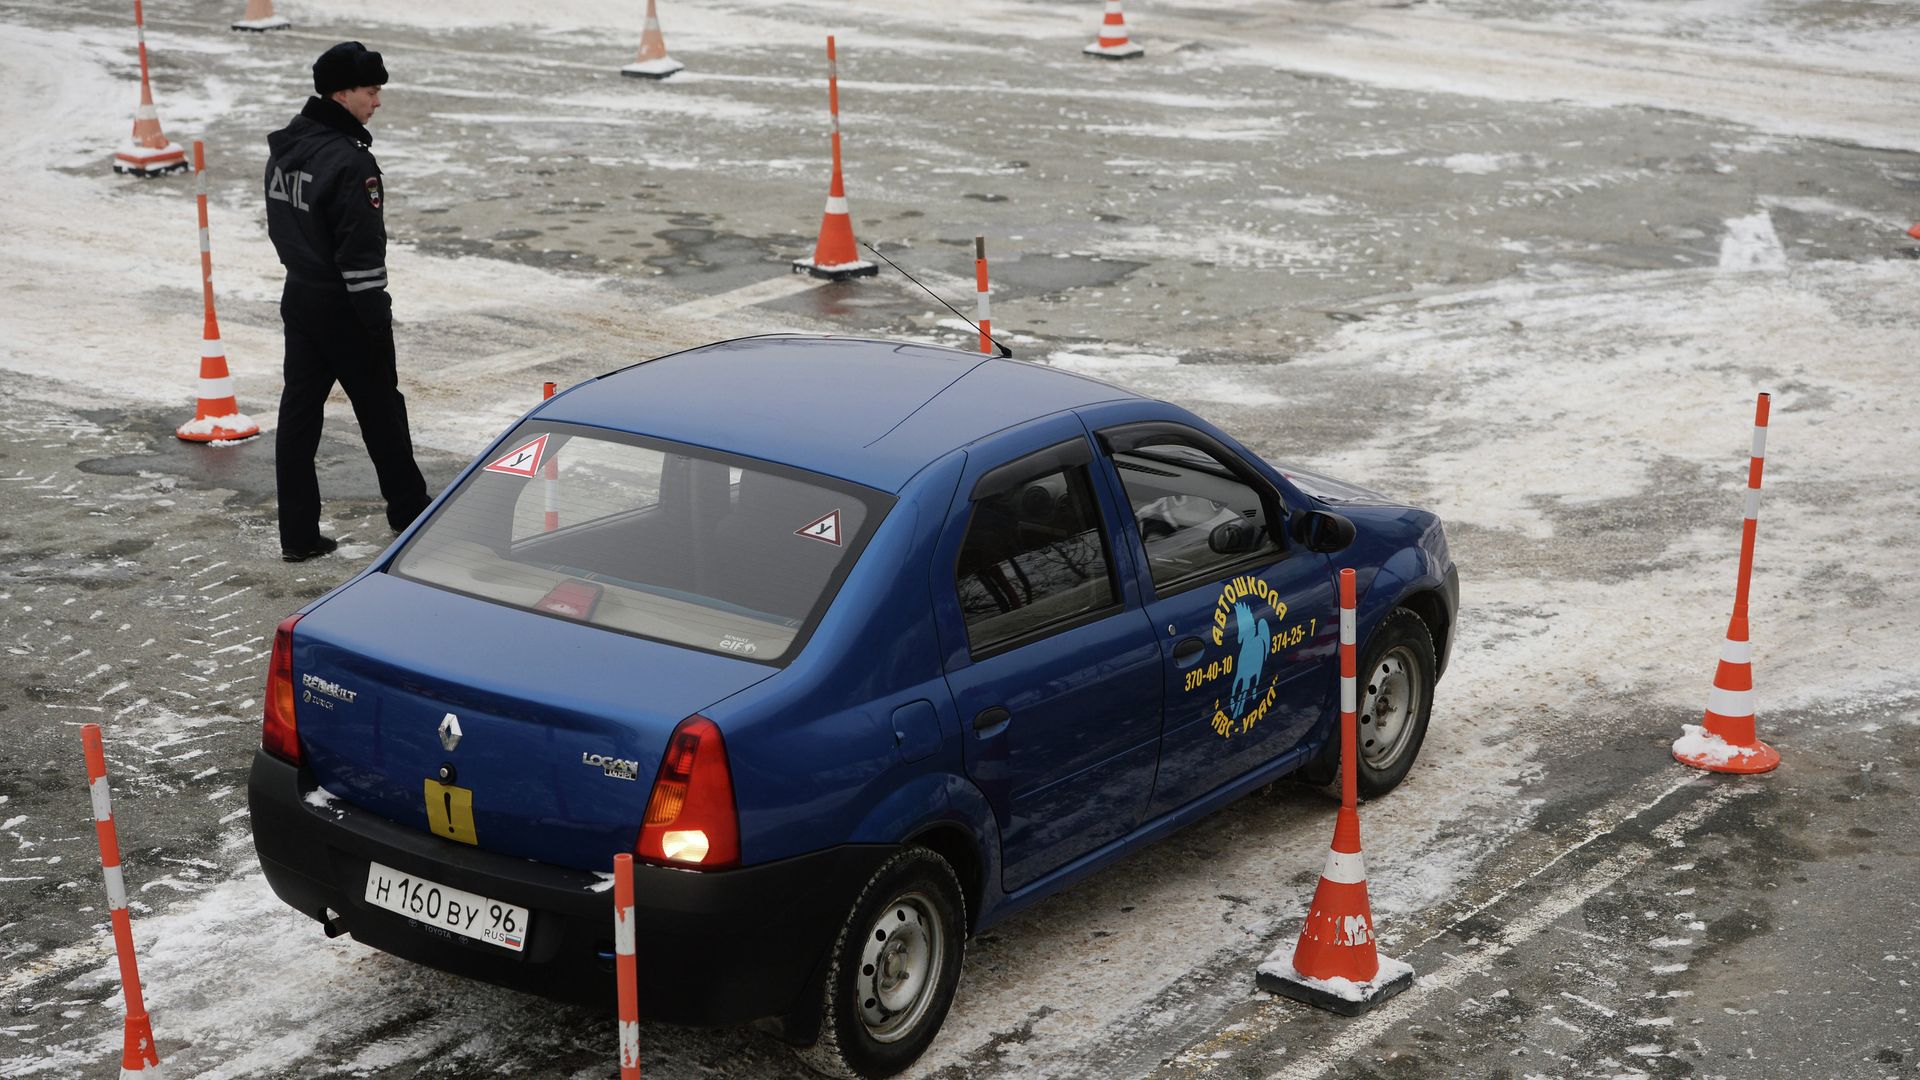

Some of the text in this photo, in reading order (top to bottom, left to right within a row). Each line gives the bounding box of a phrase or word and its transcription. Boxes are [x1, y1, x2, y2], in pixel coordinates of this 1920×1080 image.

[1212, 575, 1288, 646] АВТОШКОЛА
[1184, 655, 1233, 692] 370-40-10
[583, 752, 638, 774] LOGAN
[490, 904, 516, 933] 96
[424, 924, 451, 940] TOYOTA
[484, 928, 505, 942] RUS
